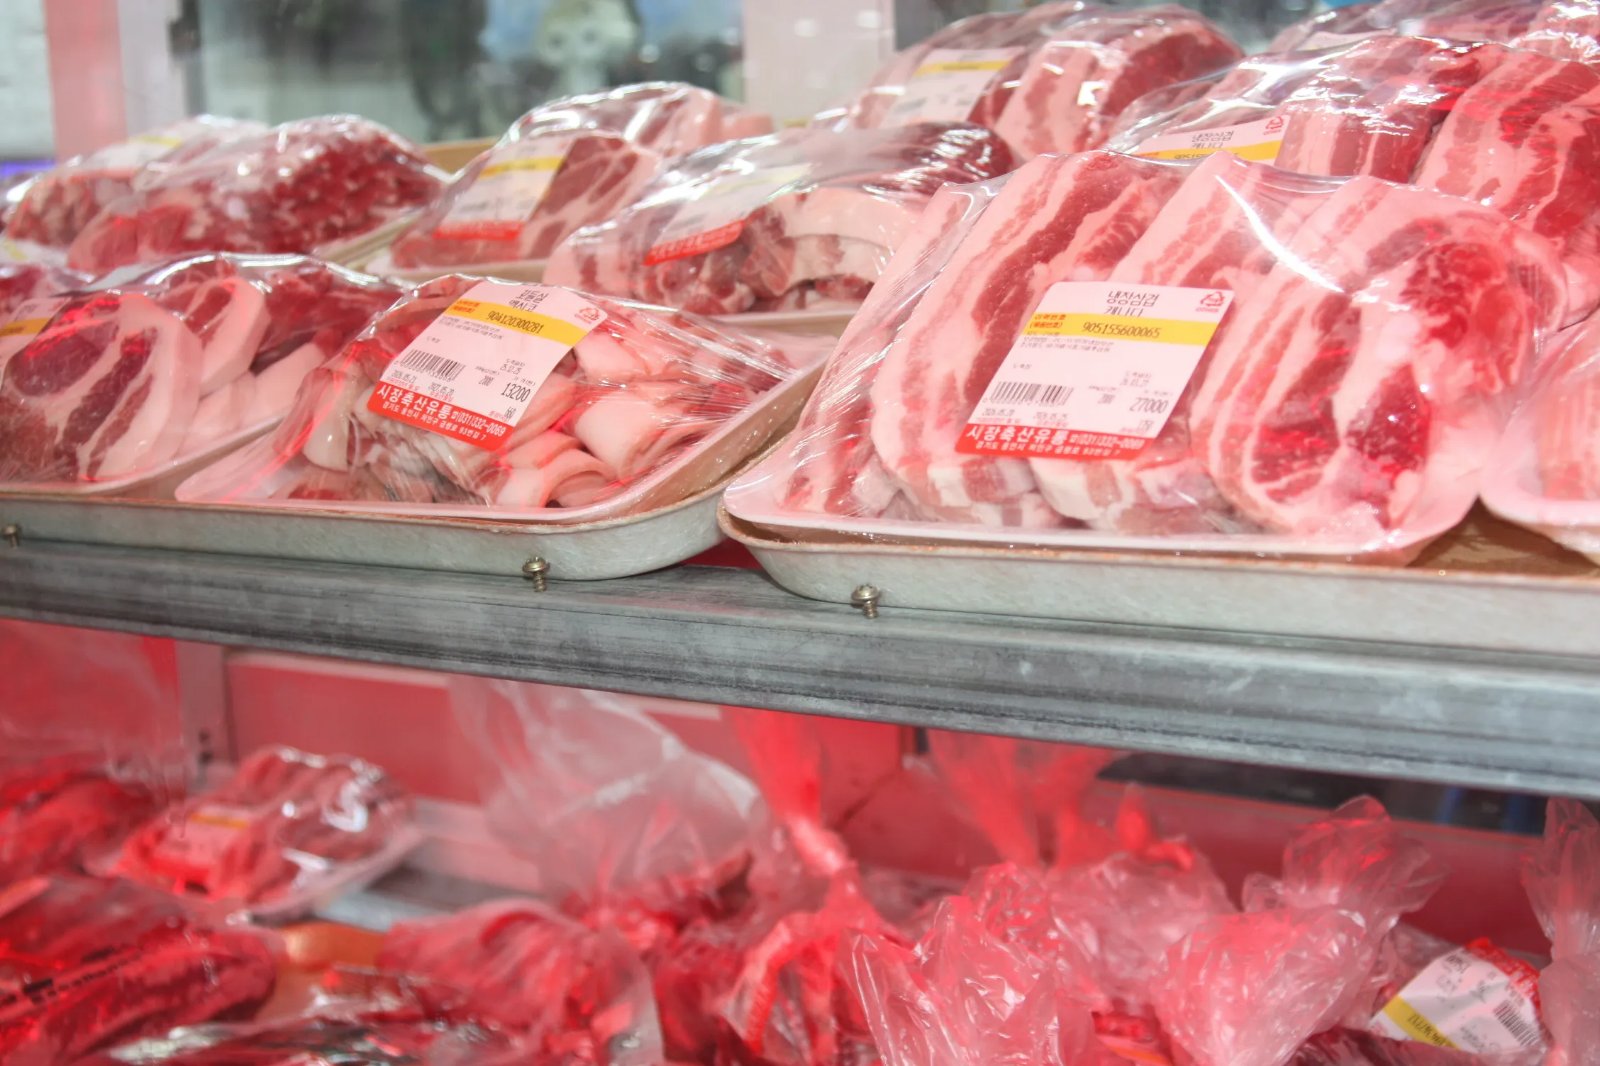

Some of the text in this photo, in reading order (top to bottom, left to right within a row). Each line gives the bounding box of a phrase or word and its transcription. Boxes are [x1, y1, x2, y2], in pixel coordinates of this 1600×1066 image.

[1106, 290, 1160, 307] 냉장삼겹
[487, 310, 545, 334] 904120300281
[1082, 321, 1163, 338] 905155600065
[377, 384, 453, 420] 시장축산유통
[501, 382, 531, 402] 13200
[1129, 396, 1169, 414] 27000
[966, 425, 1070, 446] 시장축산유통
